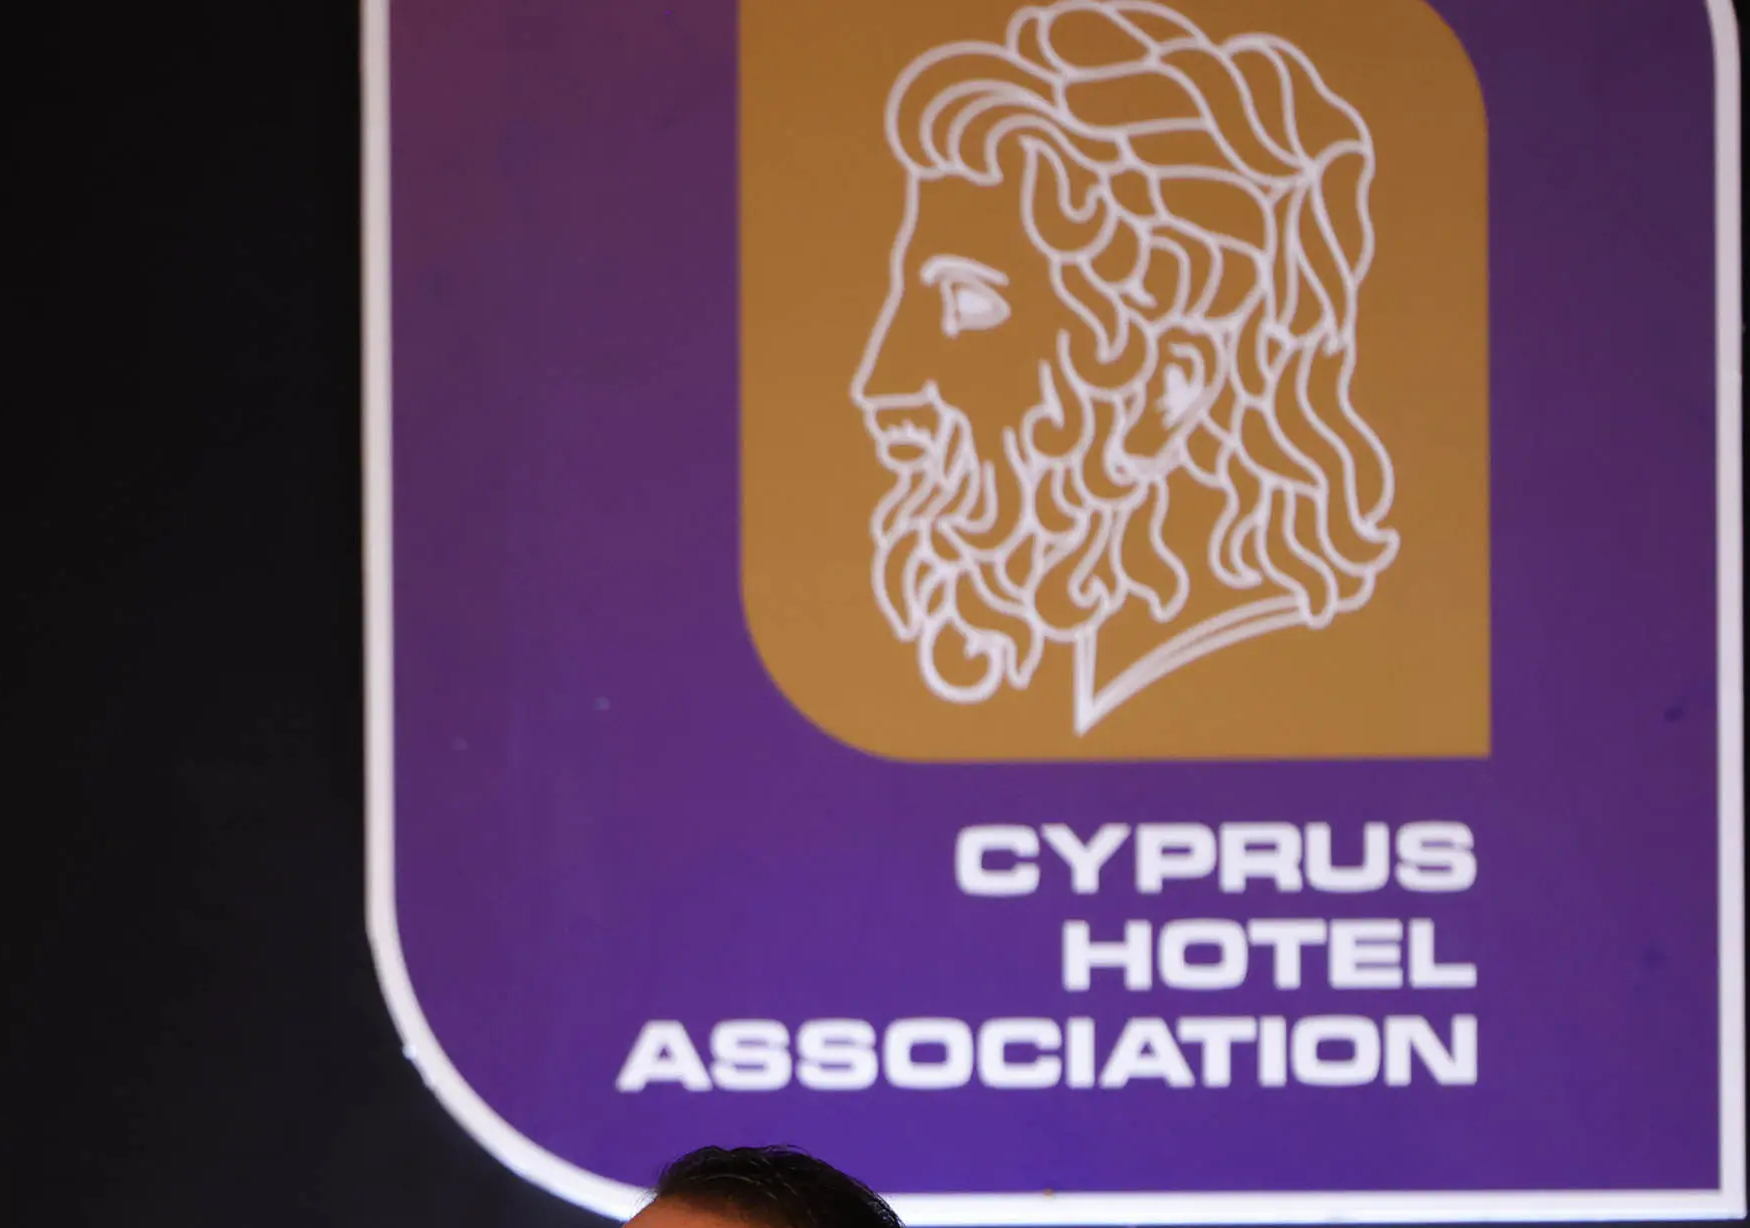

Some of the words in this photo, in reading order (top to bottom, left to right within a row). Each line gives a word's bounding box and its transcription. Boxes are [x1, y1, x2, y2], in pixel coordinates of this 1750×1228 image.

[955, 821, 1478, 896] CYPRUS
[1062, 918, 1478, 991] HOTEL
[616, 1014, 1478, 1092] ASSOCIATION
